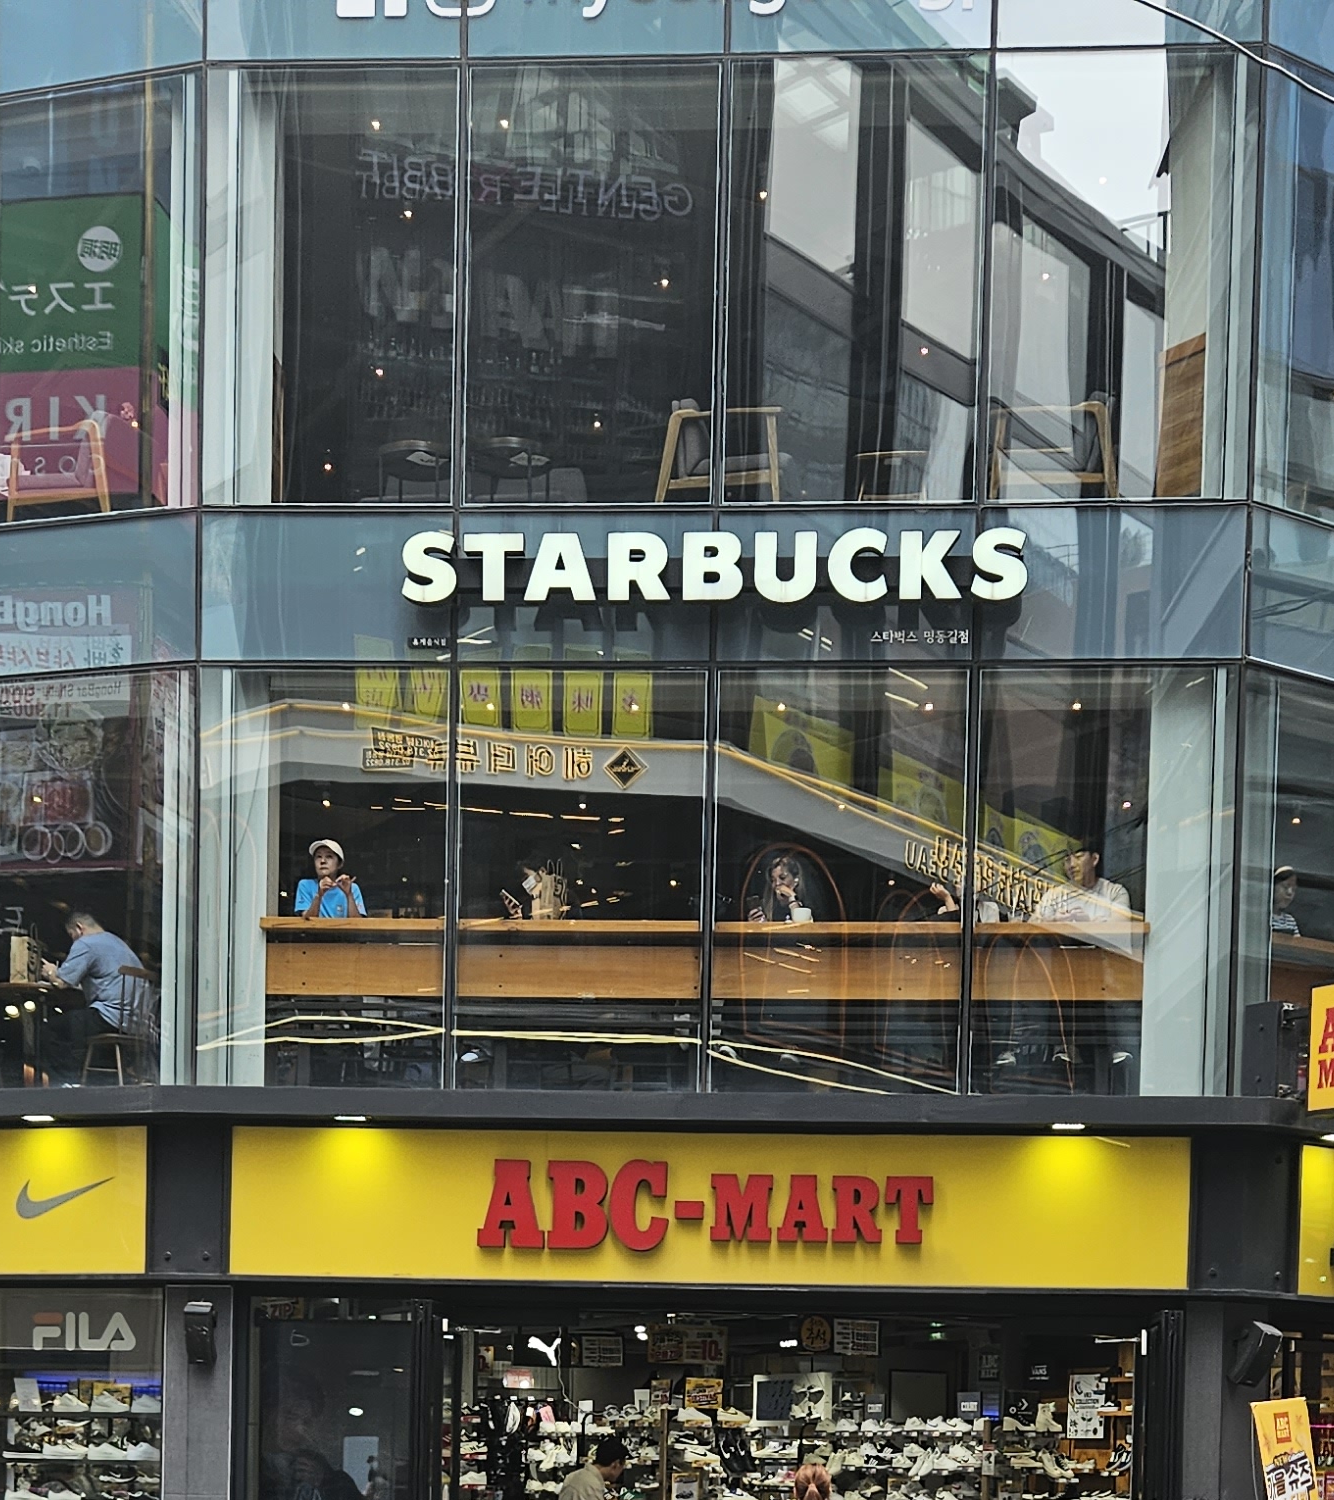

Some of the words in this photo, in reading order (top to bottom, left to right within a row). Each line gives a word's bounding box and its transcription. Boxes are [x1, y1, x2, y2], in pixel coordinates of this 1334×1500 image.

[401, 527, 1028, 603] STARBUCKS
[870, 629, 918, 645] 스타벅스
[477, 1158, 934, 1252] ABC-MART
[33, 1311, 136, 1351] FILA
